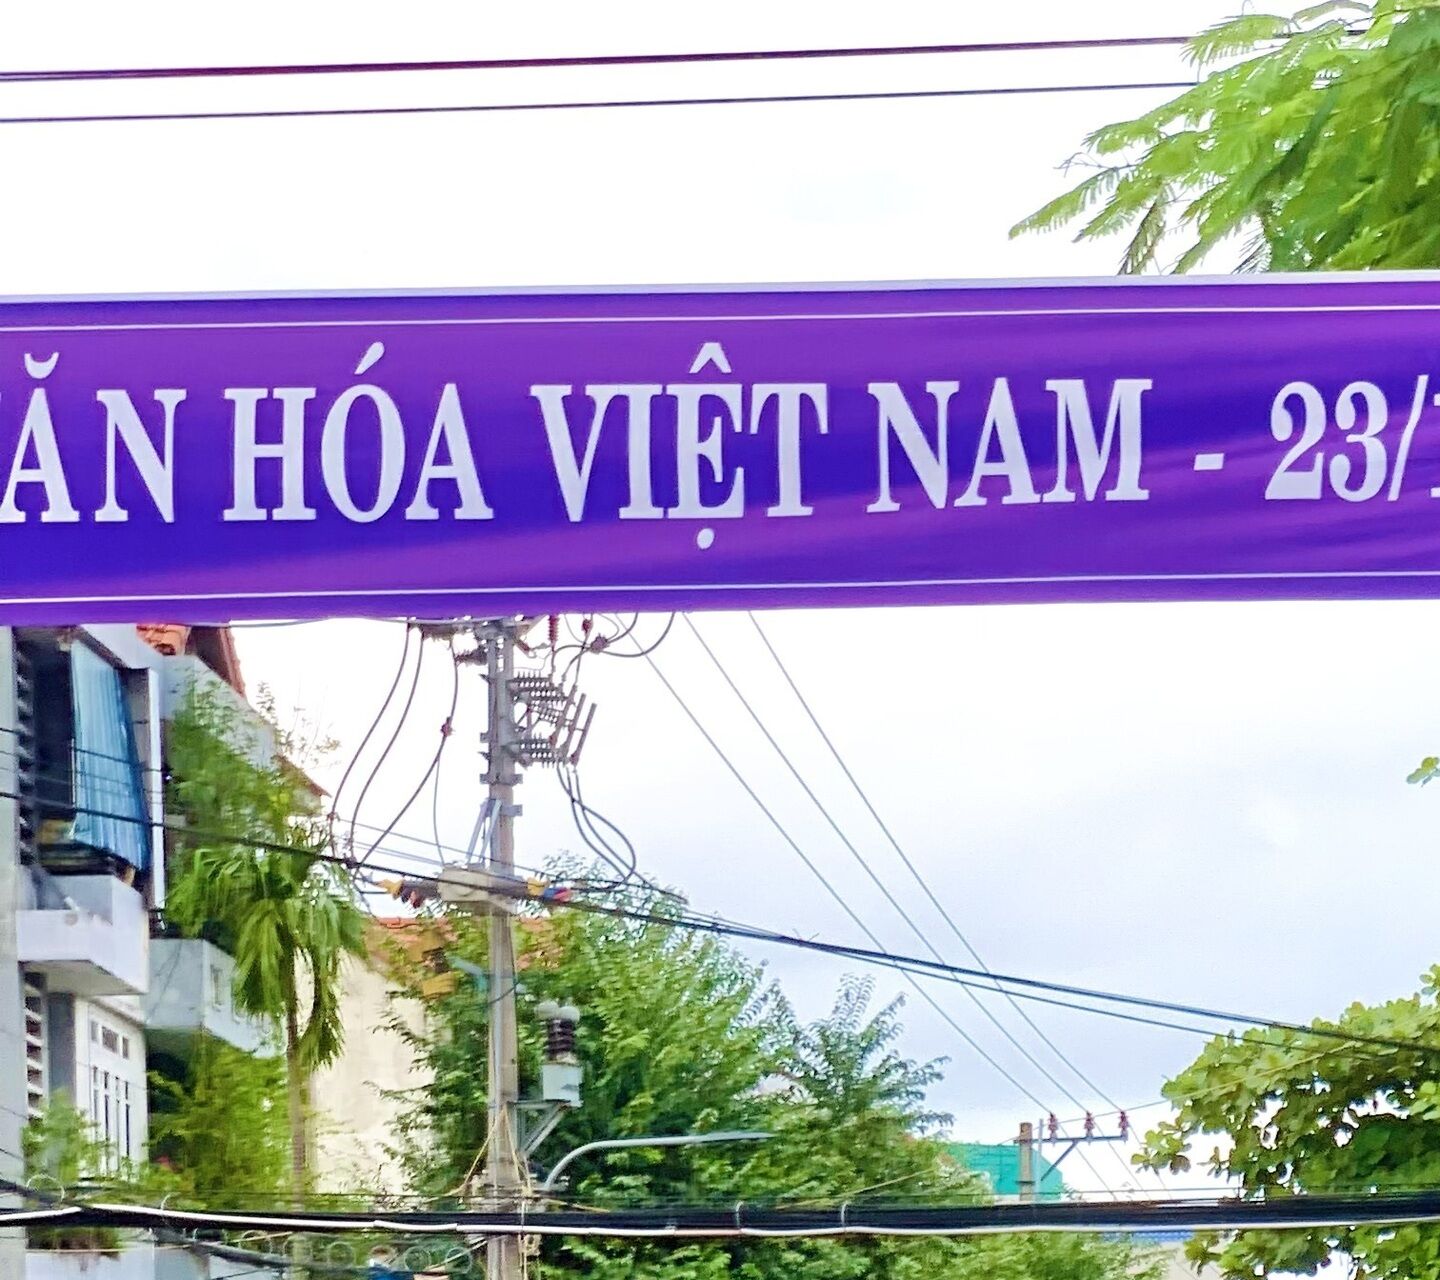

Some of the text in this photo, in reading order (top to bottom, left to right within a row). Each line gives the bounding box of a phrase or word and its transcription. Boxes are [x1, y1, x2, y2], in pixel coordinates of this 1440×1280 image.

[0, 352, 187, 523] ĂN
[223, 341, 493, 522] HÓA
[530, 342, 828, 548] VIỆT
[867, 378, 1153, 513] NAM
[1193, 453, 1224, 471] -
